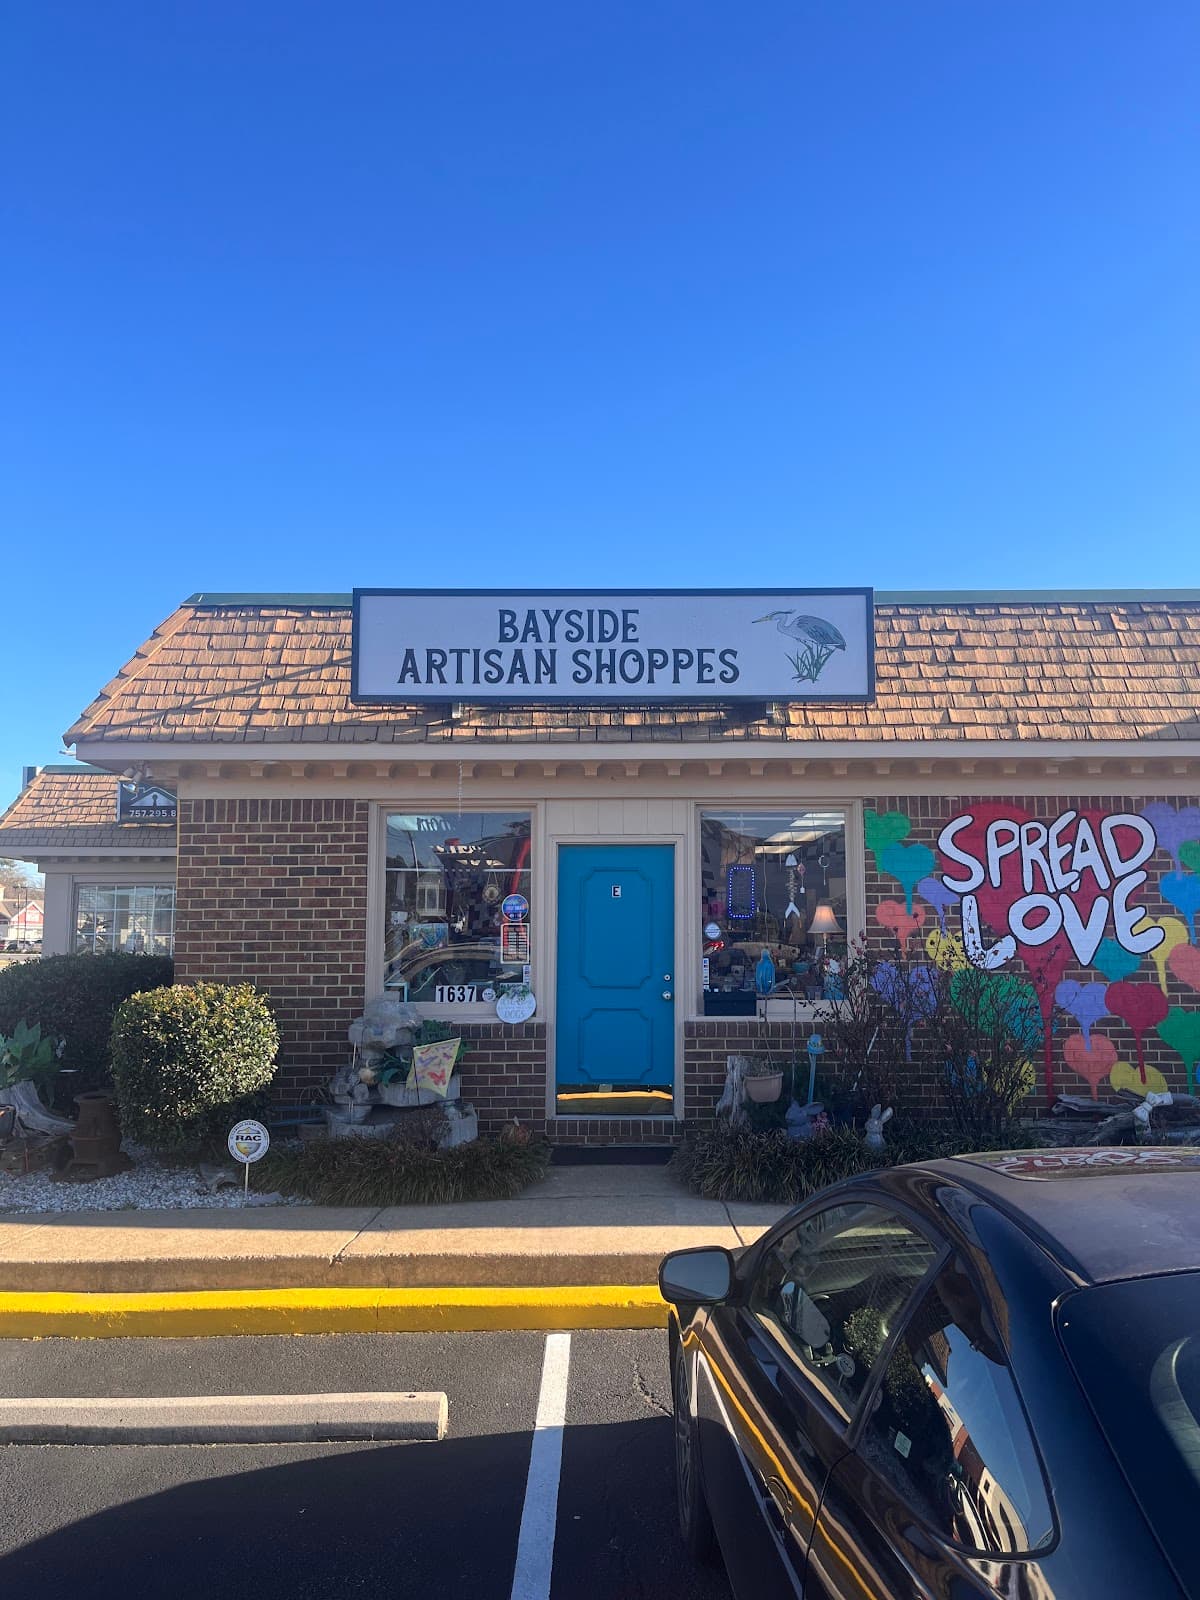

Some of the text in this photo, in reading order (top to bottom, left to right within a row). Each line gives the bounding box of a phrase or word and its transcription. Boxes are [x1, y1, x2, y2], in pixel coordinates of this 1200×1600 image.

[498, 609, 640, 643] BAYSIDE
[397, 648, 741, 685] ARTISAN SHOPPES
[938, 809, 1157, 893] SPREAD
[613, 886, 620, 897] E
[960, 871, 1166, 970] LOVE
[438, 986, 476, 1003] 1637
